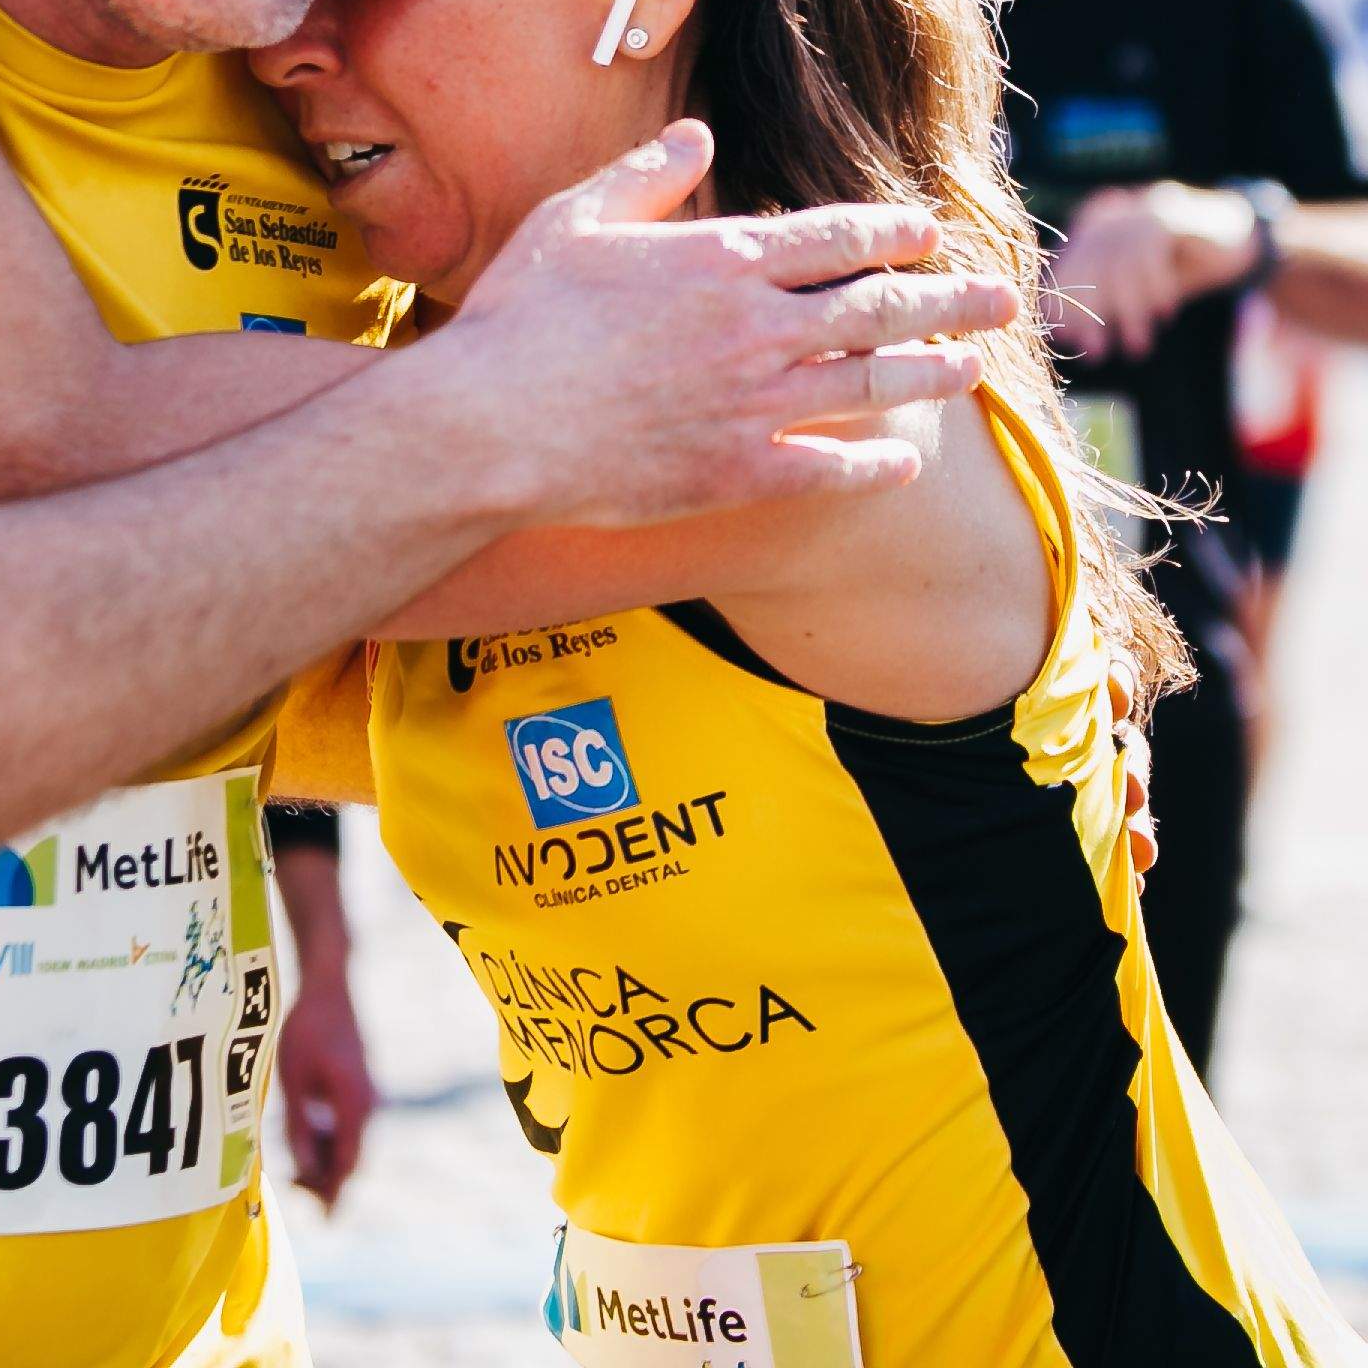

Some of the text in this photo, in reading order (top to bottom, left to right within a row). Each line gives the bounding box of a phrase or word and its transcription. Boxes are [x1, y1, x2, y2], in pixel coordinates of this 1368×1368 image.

[224, 208, 337, 249] San Sebastián
[229, 237, 323, 279] de los Reyes
[500, 642, 543, 668] los
[547, 626, 618, 659] Reyes
[524, 729, 614, 801] ISC
[75, 831, 220, 894] MetLife
[605, 860, 690, 895] DENTAL
[480, 949, 669, 1020] CLÍNICA
[505, 984, 817, 1081] MENORCA
[597, 1285, 749, 1343] MetLife
